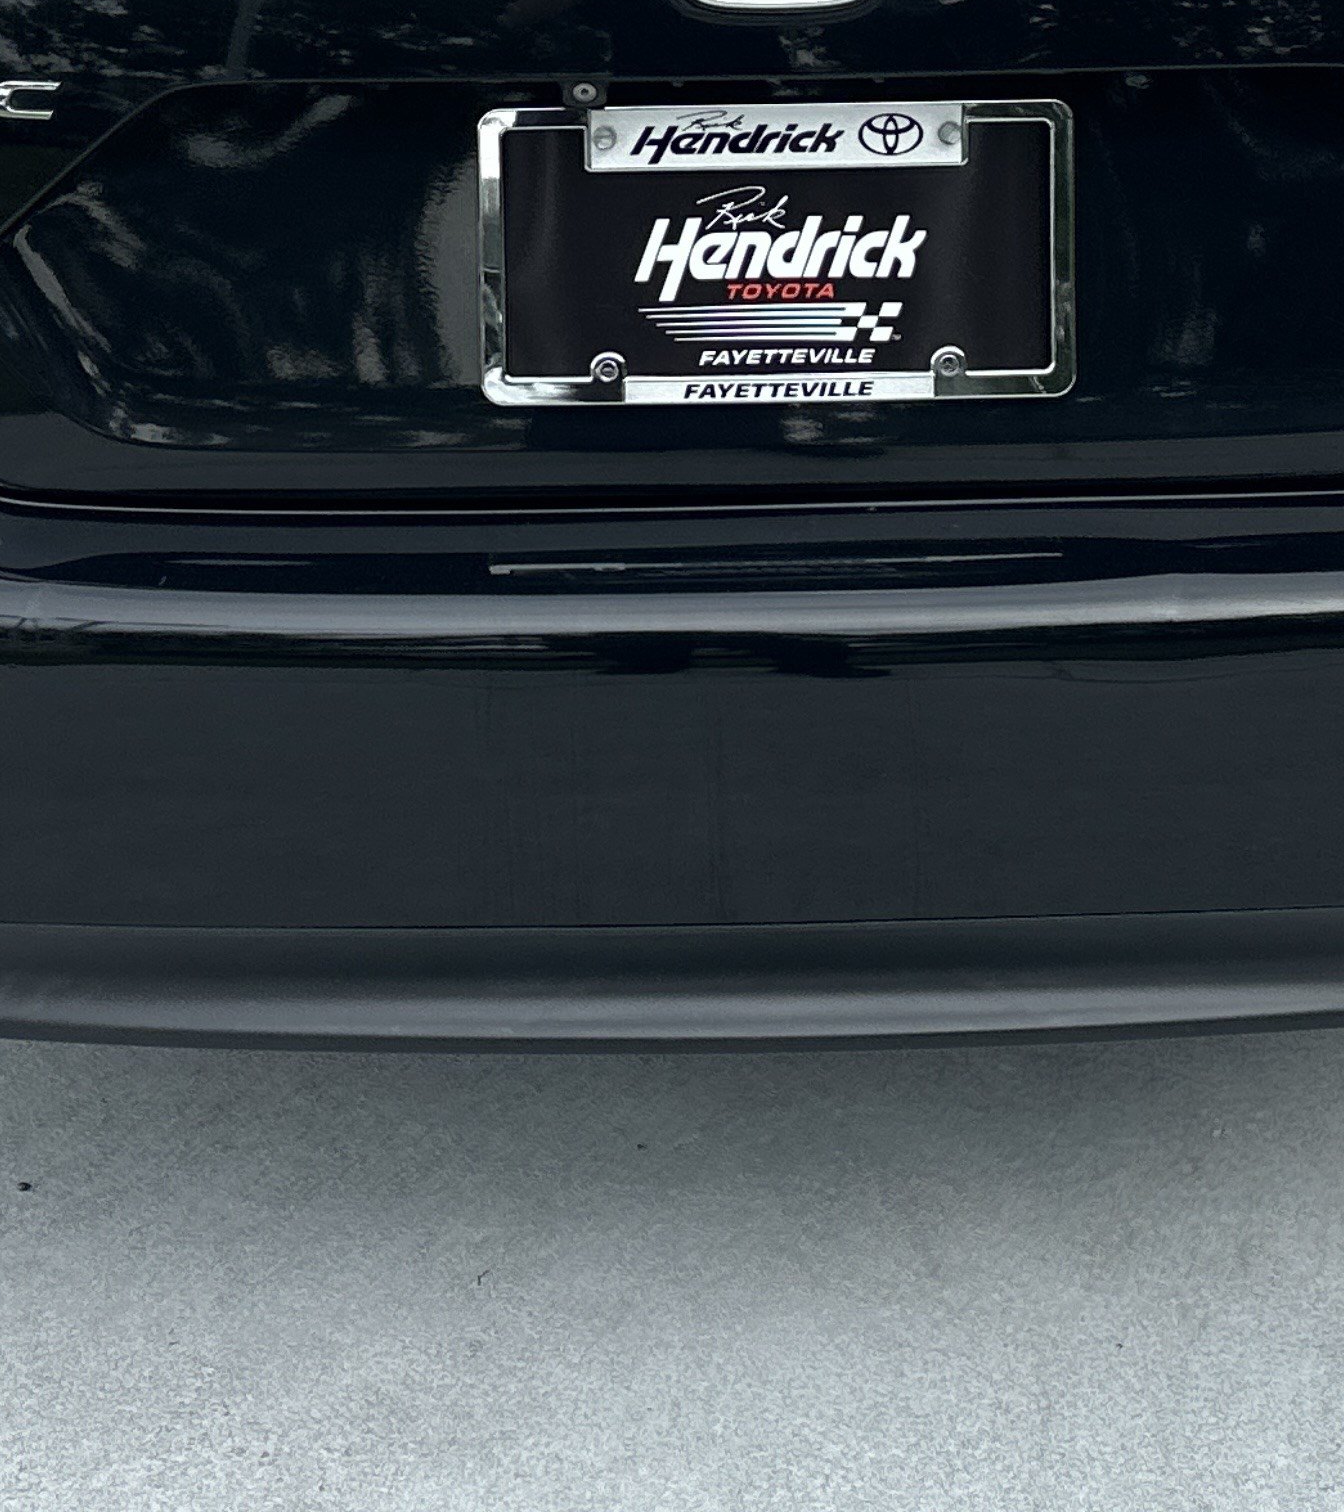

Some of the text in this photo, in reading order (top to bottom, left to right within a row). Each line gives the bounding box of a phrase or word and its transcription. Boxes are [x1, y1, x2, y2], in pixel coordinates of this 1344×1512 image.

[630, 123, 845, 164] Hendrick
[634, 215, 927, 302] Hendrick
[726, 283, 835, 300] TOYOTA
[698, 348, 876, 366] FAYETTEVILLE
[683, 381, 875, 399] FAYETTEVILLE
